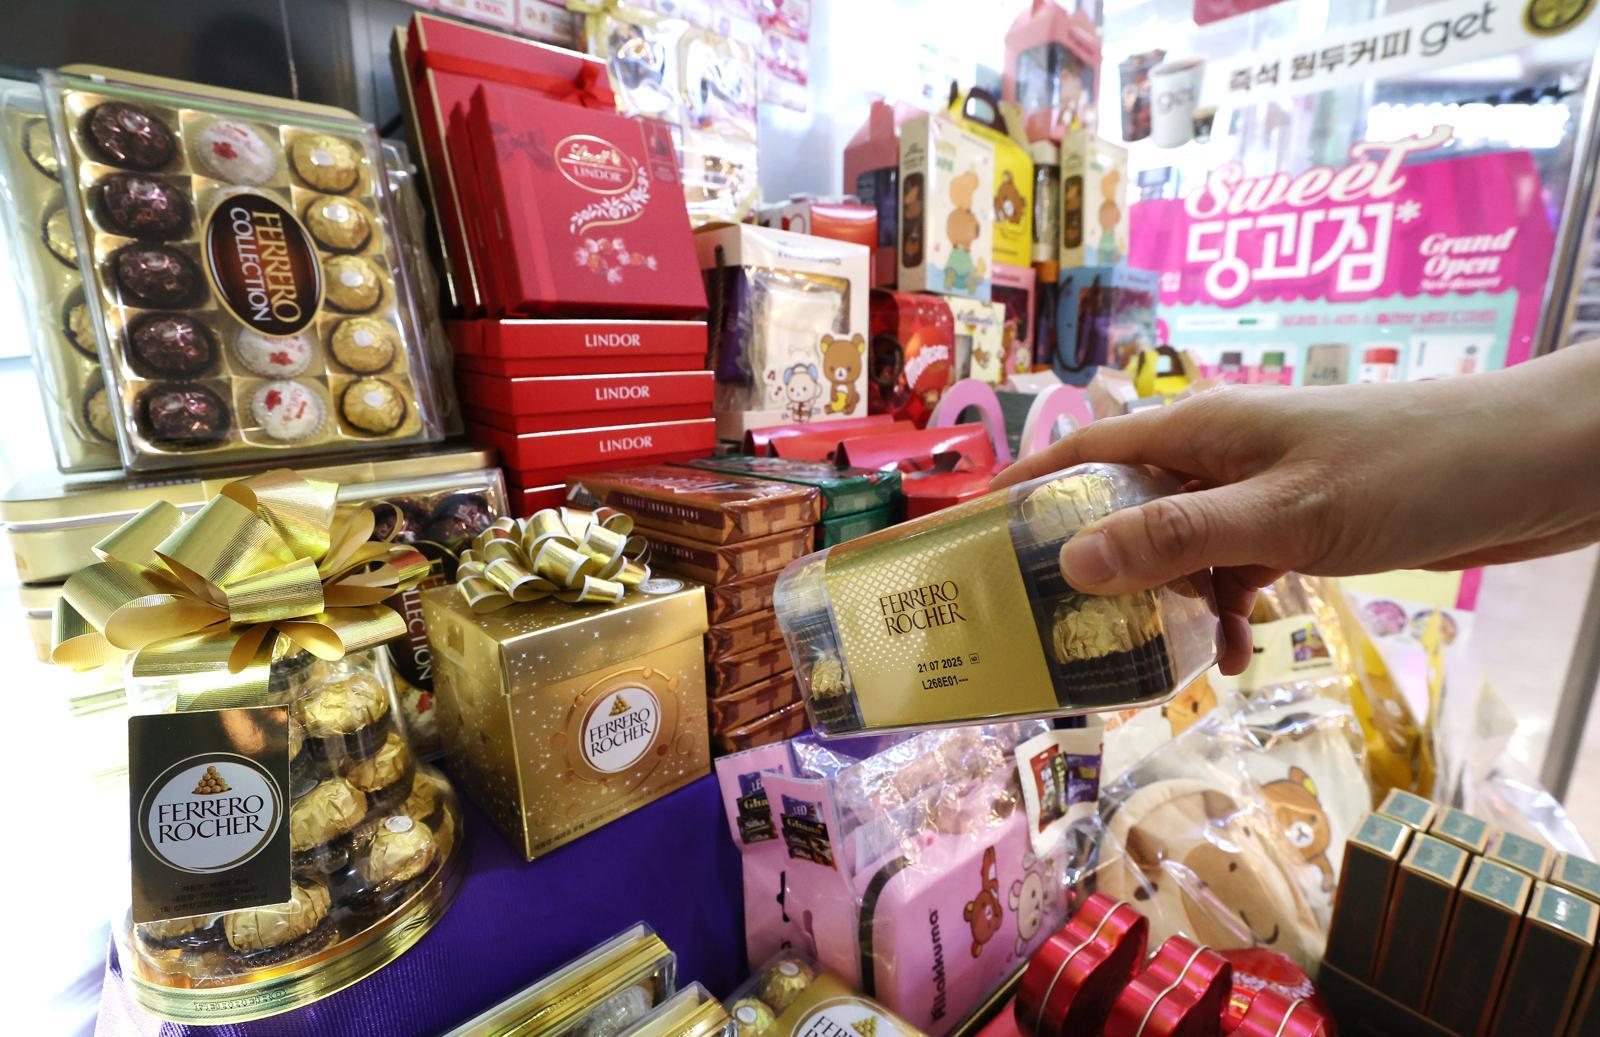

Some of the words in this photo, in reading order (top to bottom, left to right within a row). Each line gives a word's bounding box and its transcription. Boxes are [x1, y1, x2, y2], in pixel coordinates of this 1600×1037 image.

[1229, 60, 1280, 91] 즉석
[1291, 28, 1411, 81] 원두커피
[1420, 3, 1496, 57] get
[1420, 227, 1517, 256] Grand
[230, 207, 272, 322] COLLECTION
[252, 210, 302, 323] FERRERO
[1424, 256, 1500, 281] Open
[584, 333, 641, 348] LINDOR
[595, 385, 650, 401] LINDOR
[599, 436, 653, 453] LINDOR
[879, 580, 959, 616] FERRERO
[402, 585, 432, 681] LLECTION
[884, 602, 967, 636] ROCHER
[917, 663, 928, 673] 21
[929, 660, 939, 671] 07
[941, 656, 963, 669] 2025
[590, 707, 651, 743] FERRERO
[591, 722, 652, 757] ROCHER
[158, 794, 264, 823] FERRERO
[158, 814, 265, 843] ROCHER
